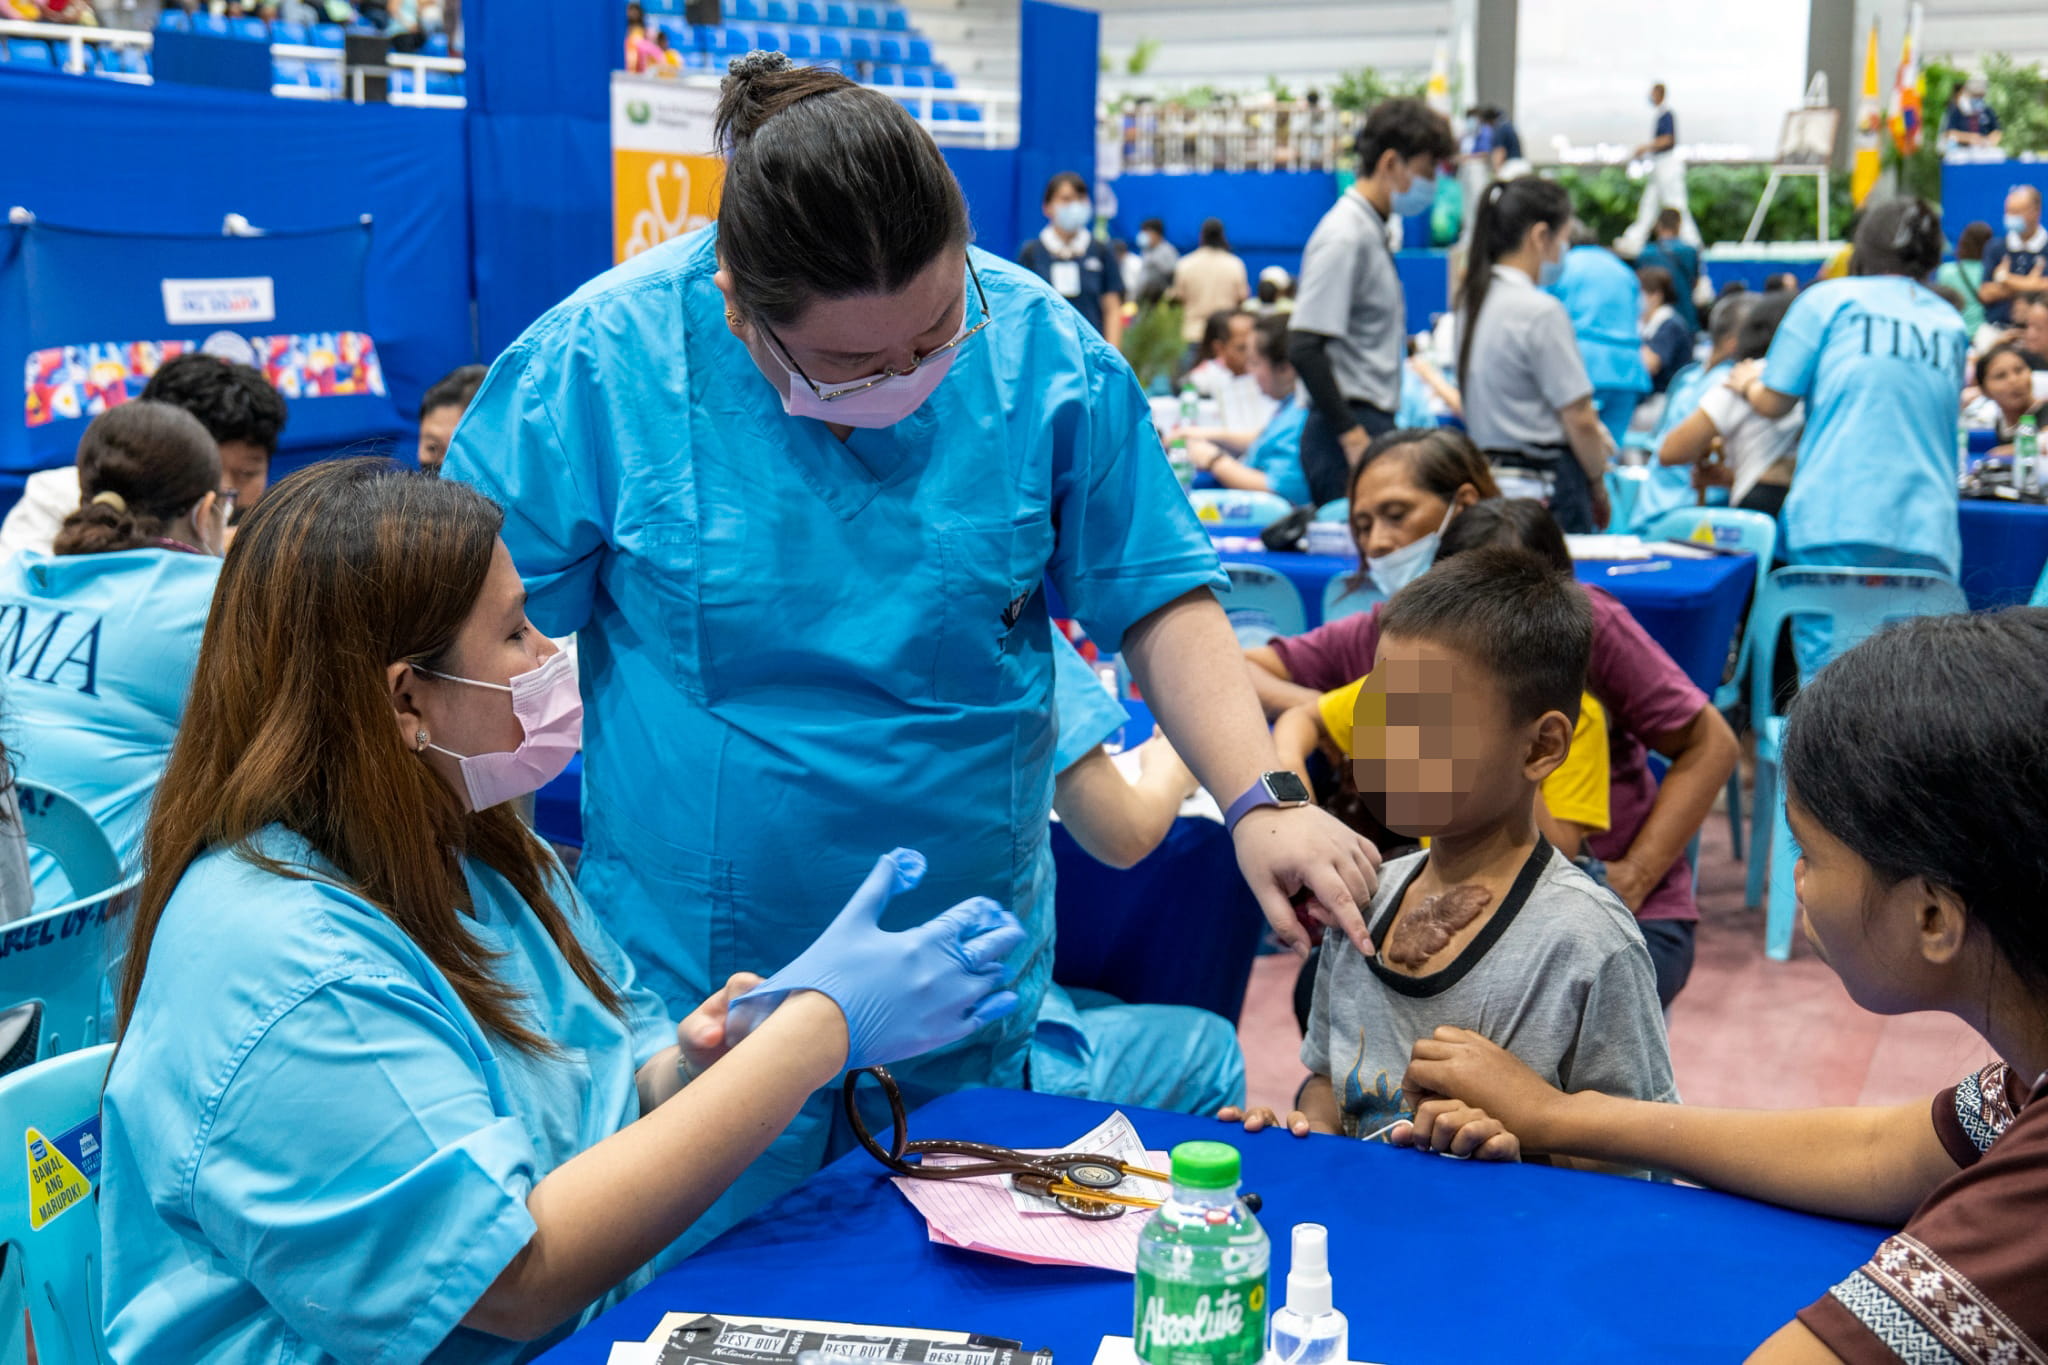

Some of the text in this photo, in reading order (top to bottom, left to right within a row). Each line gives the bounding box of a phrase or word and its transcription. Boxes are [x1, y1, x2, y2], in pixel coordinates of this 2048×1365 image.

[0, 604, 103, 698] MA
[0, 917, 55, 958] REL
[32, 1155, 63, 1184] BAWAL
[45, 1174, 63, 1197] ANG
[39, 1182, 82, 1221] MARUPOK!
[1139, 1288, 1245, 1354] Absolute
[720, 1333, 781, 1351] BEST BUY
[859, 1345, 885, 1358] BUY
[929, 1352, 961, 1364] BEST
